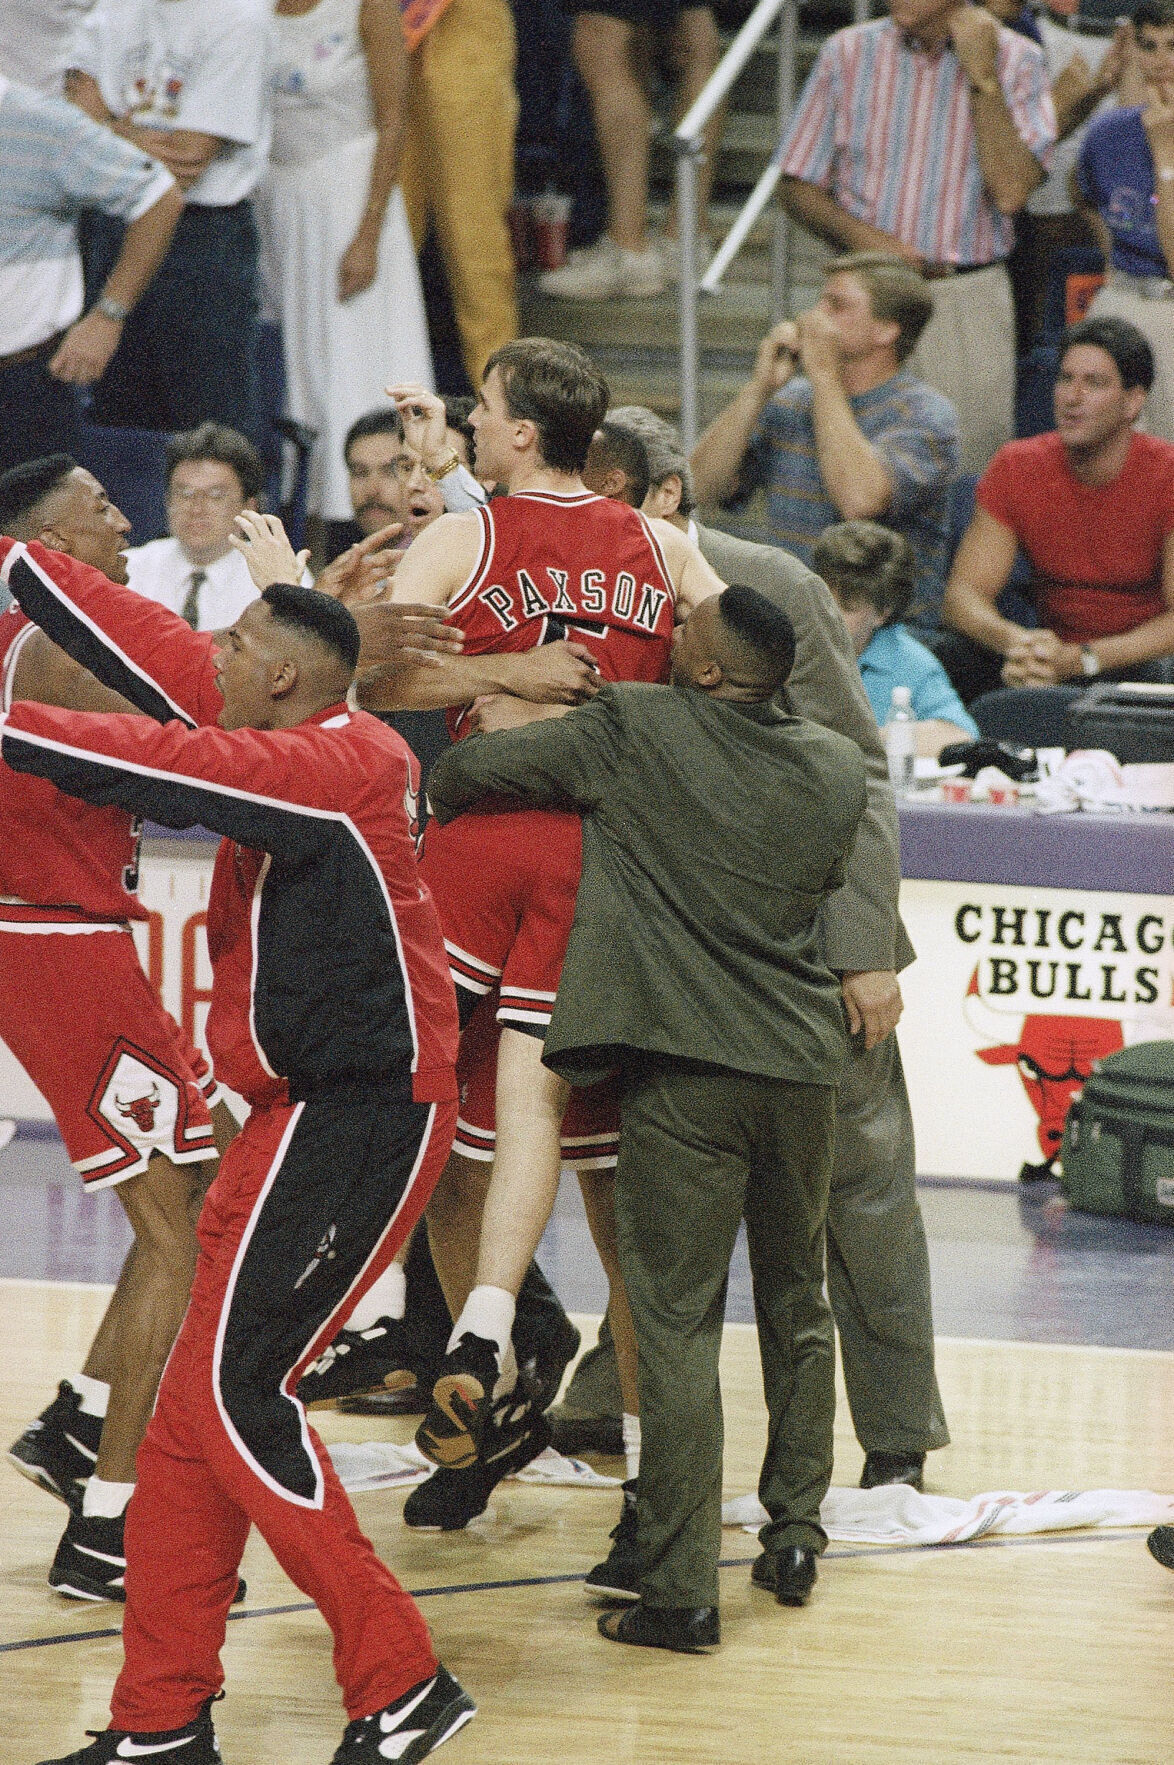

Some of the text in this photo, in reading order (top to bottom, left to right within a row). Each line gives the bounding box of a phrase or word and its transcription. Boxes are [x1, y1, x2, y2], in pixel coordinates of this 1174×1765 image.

[478, 567, 668, 632] PAXSON
[955, 903, 1174, 953] CHICAG
[988, 957, 1159, 1004] BULLS
